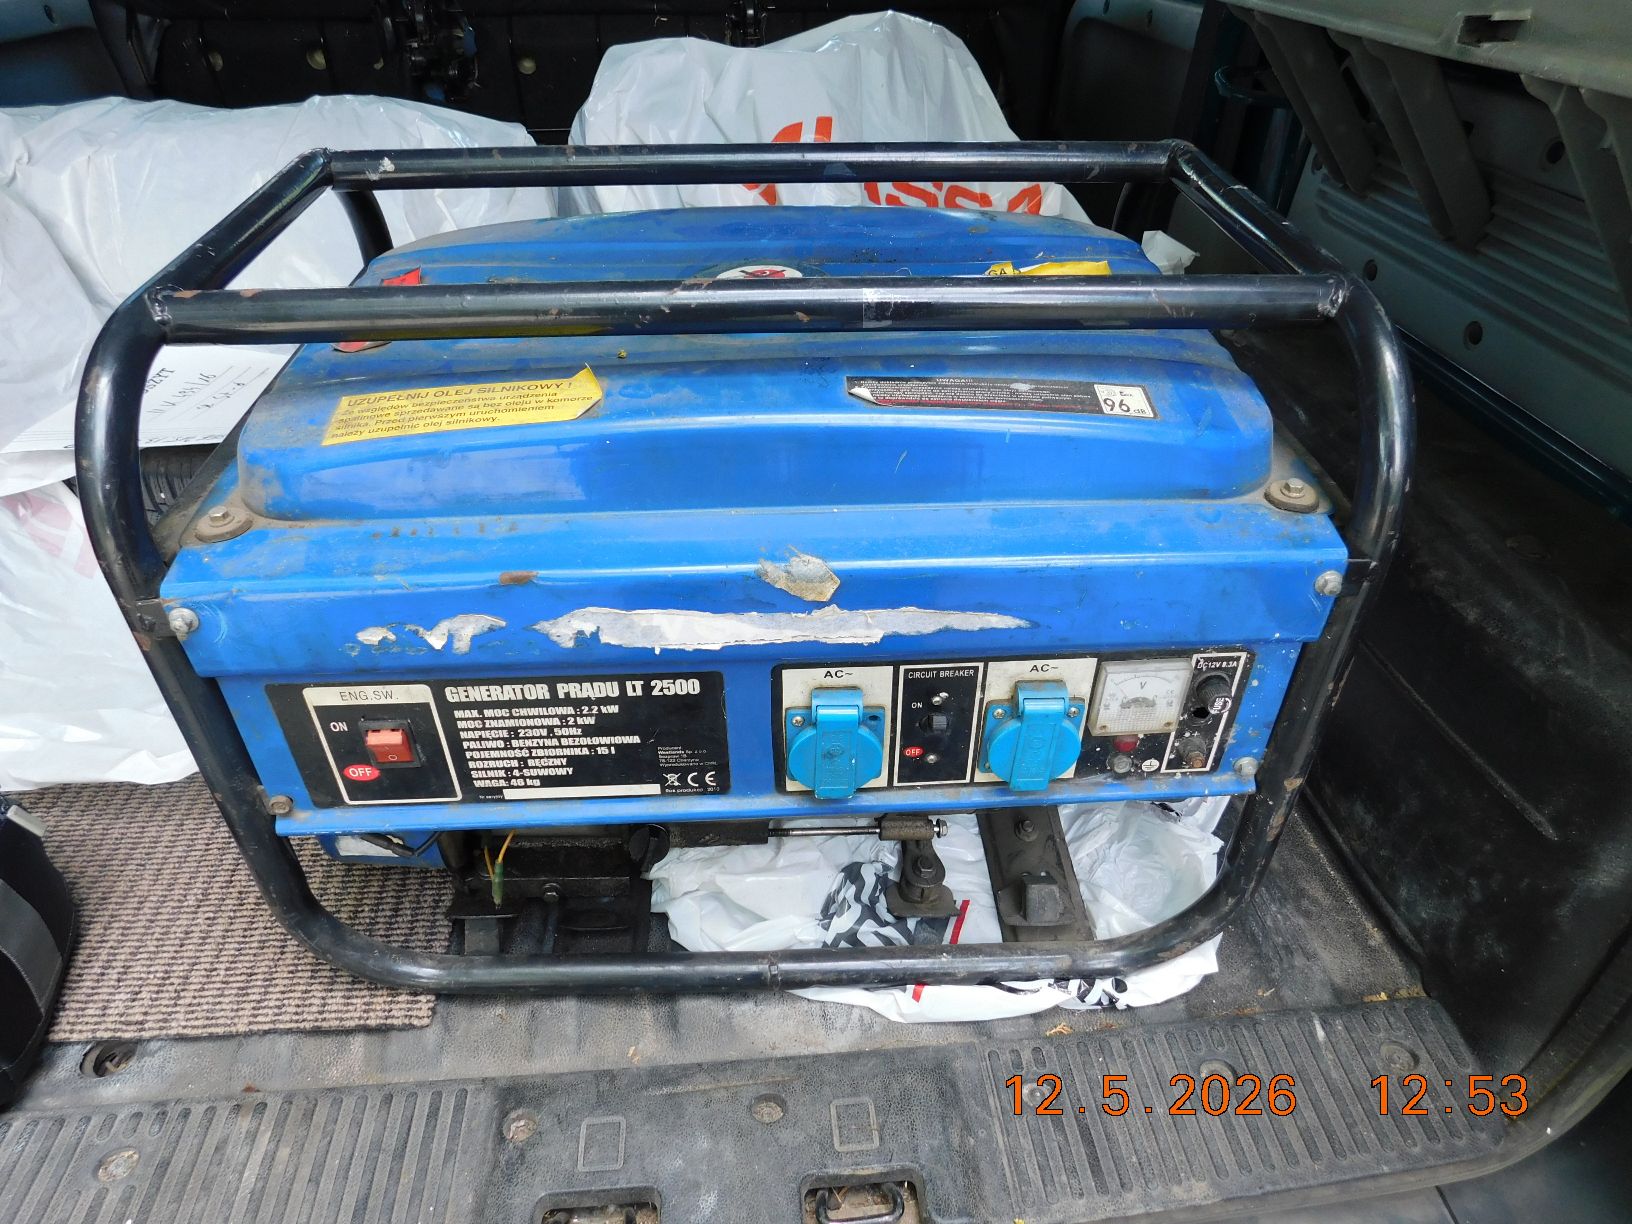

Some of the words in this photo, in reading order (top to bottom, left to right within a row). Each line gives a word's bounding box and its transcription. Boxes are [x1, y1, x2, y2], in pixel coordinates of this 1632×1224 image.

[348, 391, 430, 406] UZUPEŁNIJ
[433, 388, 473, 397] OLEJ
[477, 382, 564, 394] SILNIKOWY
[1103, 397, 1130, 413] 96
[338, 412, 391, 424] spalinowe
[394, 404, 464, 417] sprzedawane
[505, 399, 532, 407] oleju
[375, 417, 405, 425] Przed
[408, 412, 466, 423] pierwszym
[469, 405, 554, 416] uruchomieniem
[423, 420, 442, 428] olej
[908, 670, 937, 679] CIRCUIT
[939, 669, 974, 678] BREAKER
[444, 683, 550, 703] GENERATOR
[556, 681, 620, 701] PRĄDU
[625, 680, 644, 697] LT
[650, 678, 701, 696] 2500
[1140, 681, 1147, 690] V
[453, 709, 483, 719] MAX.
[483, 708, 510, 718] MOC
[511, 706, 575, 717] CHWILOWA
[581, 705, 599, 714] 2.2
[600, 704, 619, 714] kW
[329, 721, 348, 732] ON
[457, 720, 483, 729] MOC
[484, 717, 561, 728] ZNAMIONOWA
[567, 717, 576, 725] 2
[576, 716, 596, 725] kW
[517, 728, 548, 737] 230V
[553, 727, 583, 736] 50Hz
[462, 740, 505, 749] PALIWO
[511, 738, 560, 748] BENZYNA
[465, 748, 529, 759] POJEMNOŚĆ
[531, 747, 590, 757] ZBIORNIKA
[596, 746, 609, 755] 15
[905, 748, 921, 756] OFF
[468, 760, 519, 769] ROZRUCH
[348, 767, 373, 777] OFF
[470, 769, 507, 778] SILNIK
[512, 767, 574, 777] 4-SUWOWY
[525, 778, 541, 787] kg
